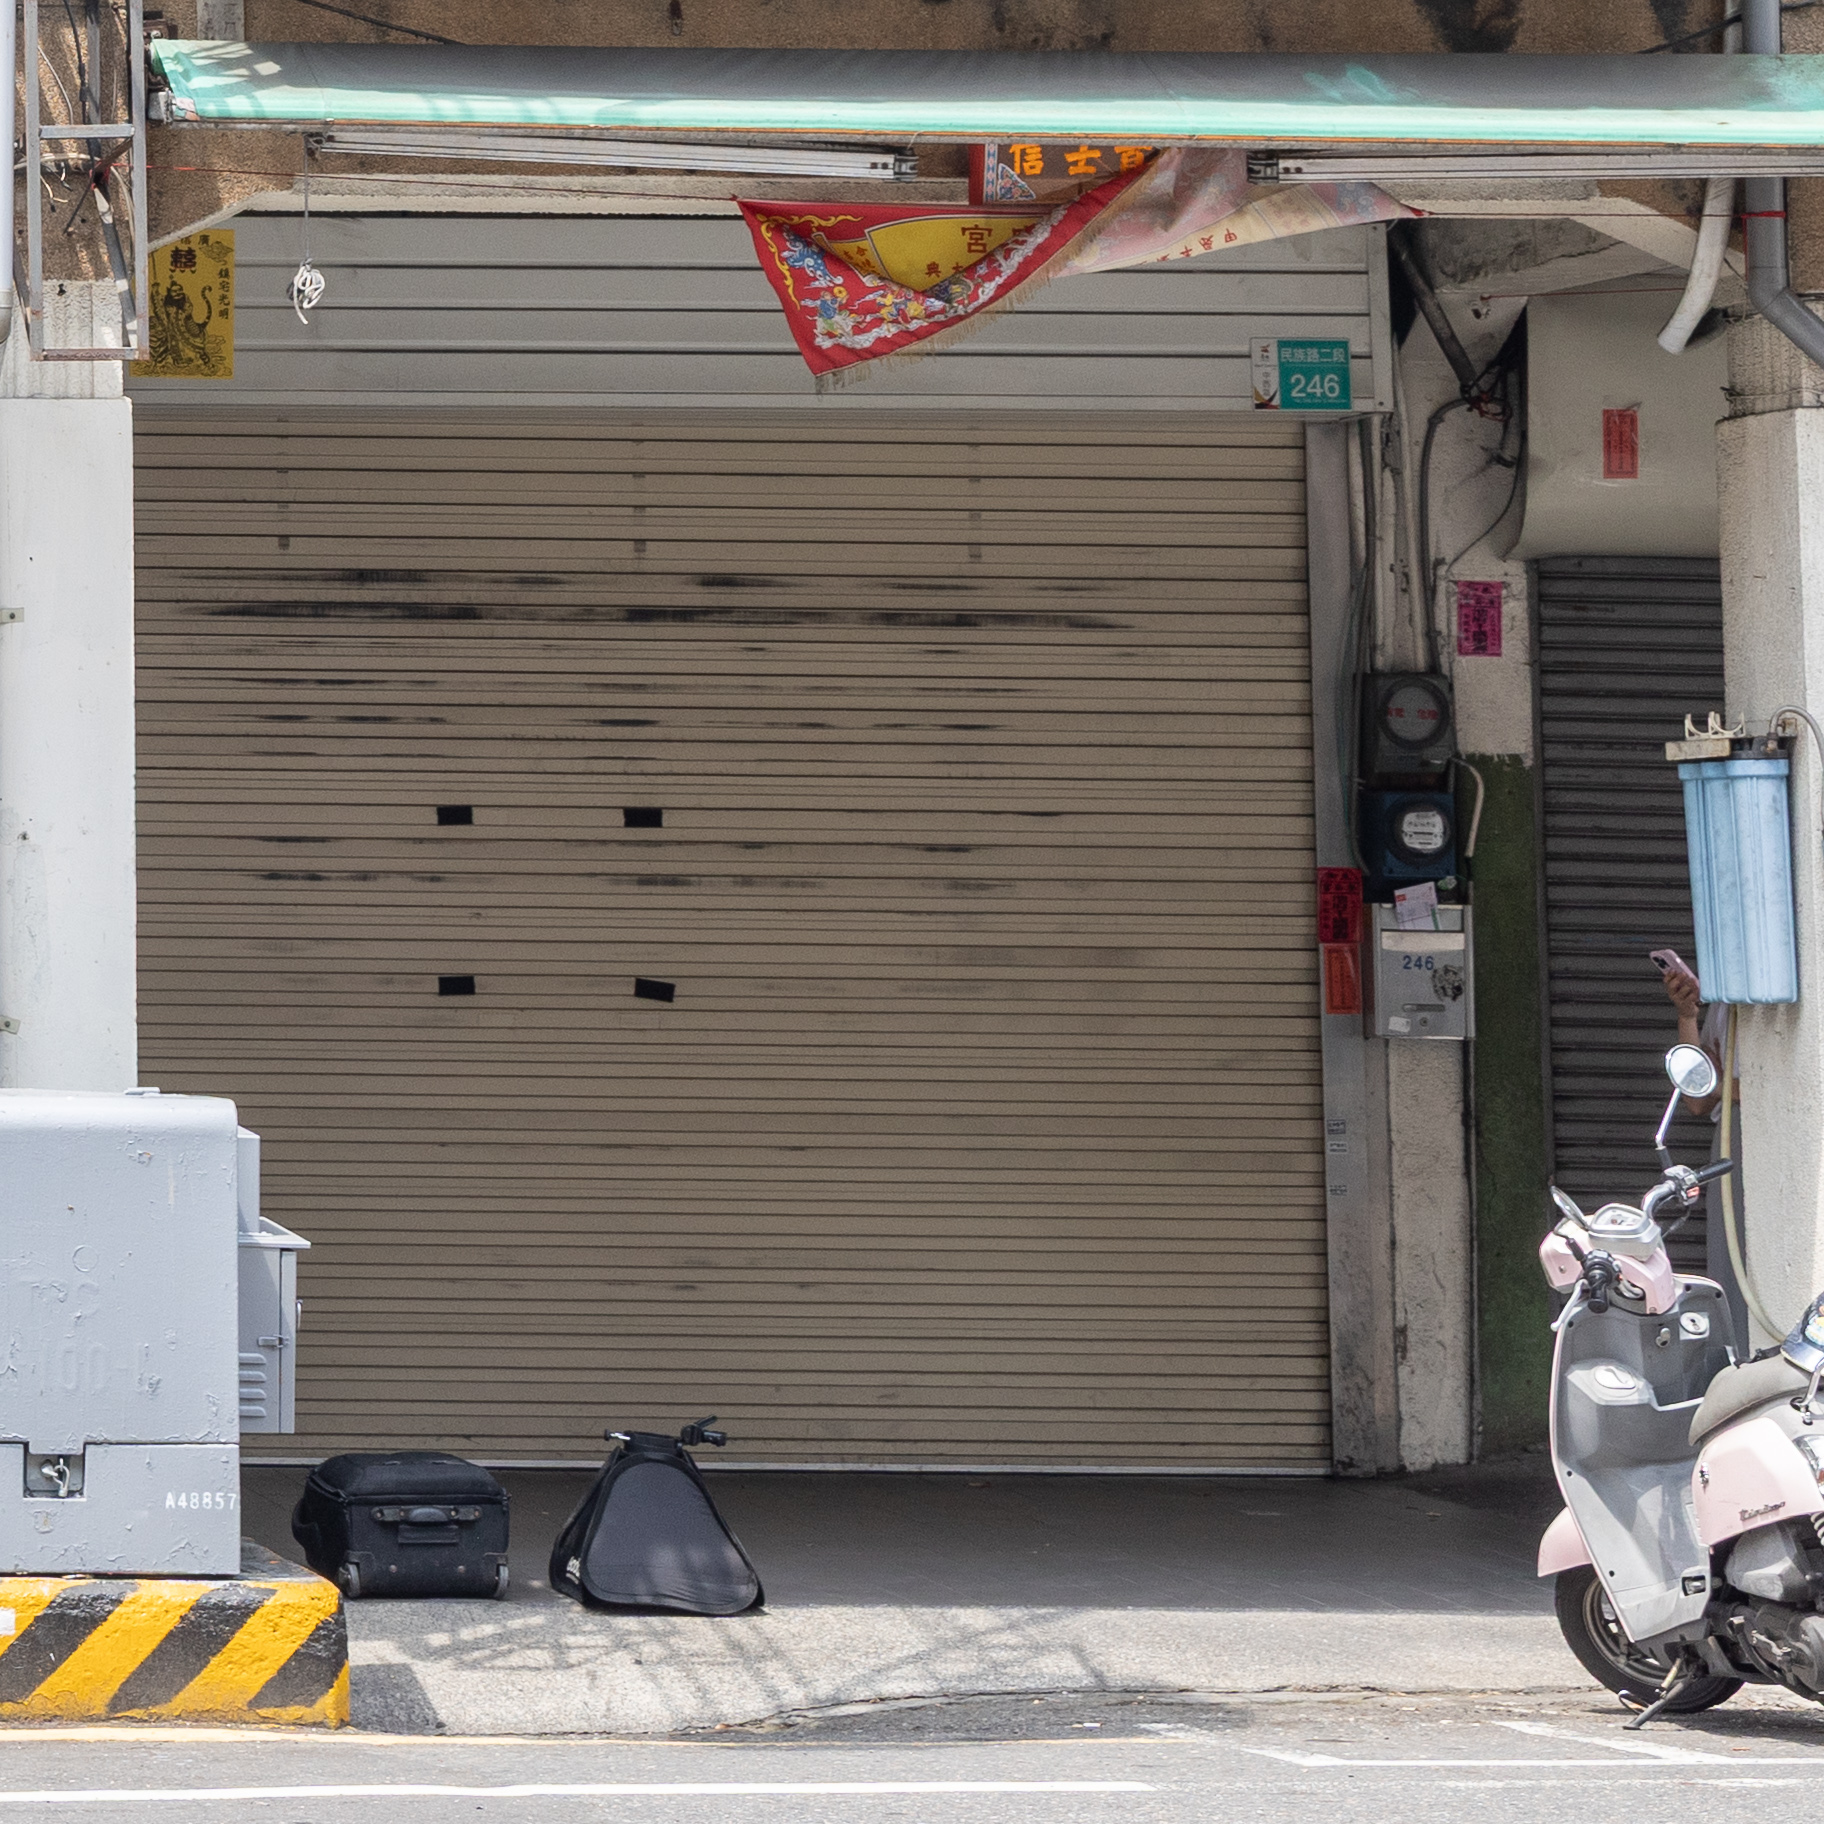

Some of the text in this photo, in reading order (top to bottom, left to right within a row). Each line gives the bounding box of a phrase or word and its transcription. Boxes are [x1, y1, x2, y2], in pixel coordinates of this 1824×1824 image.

[1280, 348, 1346, 363] 民族路二段
[1290, 374, 1340, 397] 246
[1403, 954, 1434, 970] 246
[165, 1491, 237, 1511] A48857
